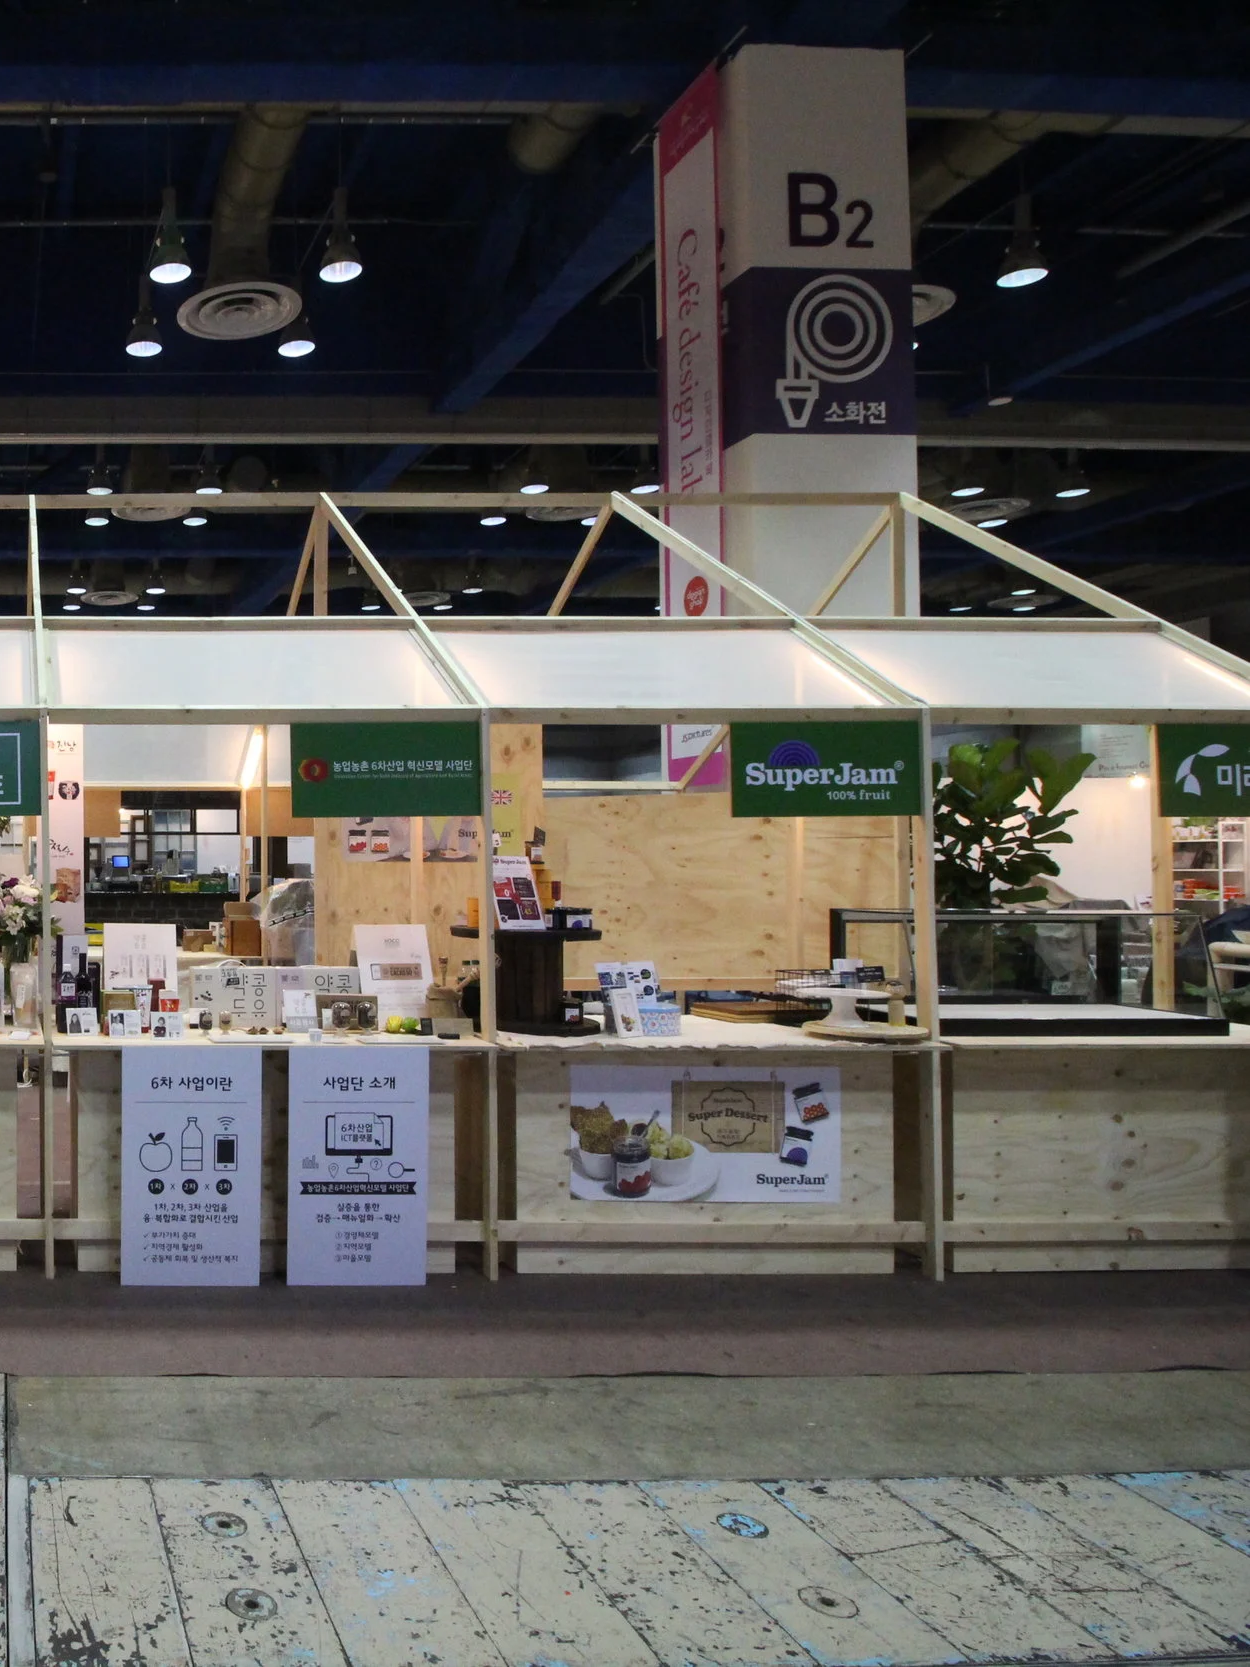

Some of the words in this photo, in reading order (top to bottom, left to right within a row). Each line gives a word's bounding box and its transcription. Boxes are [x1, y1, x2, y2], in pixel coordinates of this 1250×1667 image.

[787, 172, 874, 249] B2
[676, 228, 700, 323] Café
[672, 327, 701, 441] design
[824, 401, 887, 425] 소화전
[333, 760, 369, 772] 농업농촌
[371, 760, 404, 772] 6차산업
[407, 760, 443, 772] 혁신모델
[445, 760, 473, 772] 사업단
[826, 790, 857, 800] 100%
[859, 789, 891, 800] fruit
[151, 1076, 172, 1090] 6차
[178, 1076, 233, 1092] 사업이란
[323, 1076, 364, 1092] 사업단
[369, 1076, 396, 1090] 소개
[688, 1110, 724, 1123] Super
[724, 1107, 769, 1123] Dessert
[340, 1123, 373, 1134] 6차산업
[184, 1183, 196, 1191] 2차
[218, 1183, 230, 1191] 3차
[388, 1183, 409, 1193] 사업단
[188, 1203, 201, 1212] 3차
[204, 1202, 228, 1213] 산업을
[363, 1202, 380, 1213] 통한
[188, 1214, 221, 1224] 결합시킨
[222, 1214, 239, 1224] 산업
